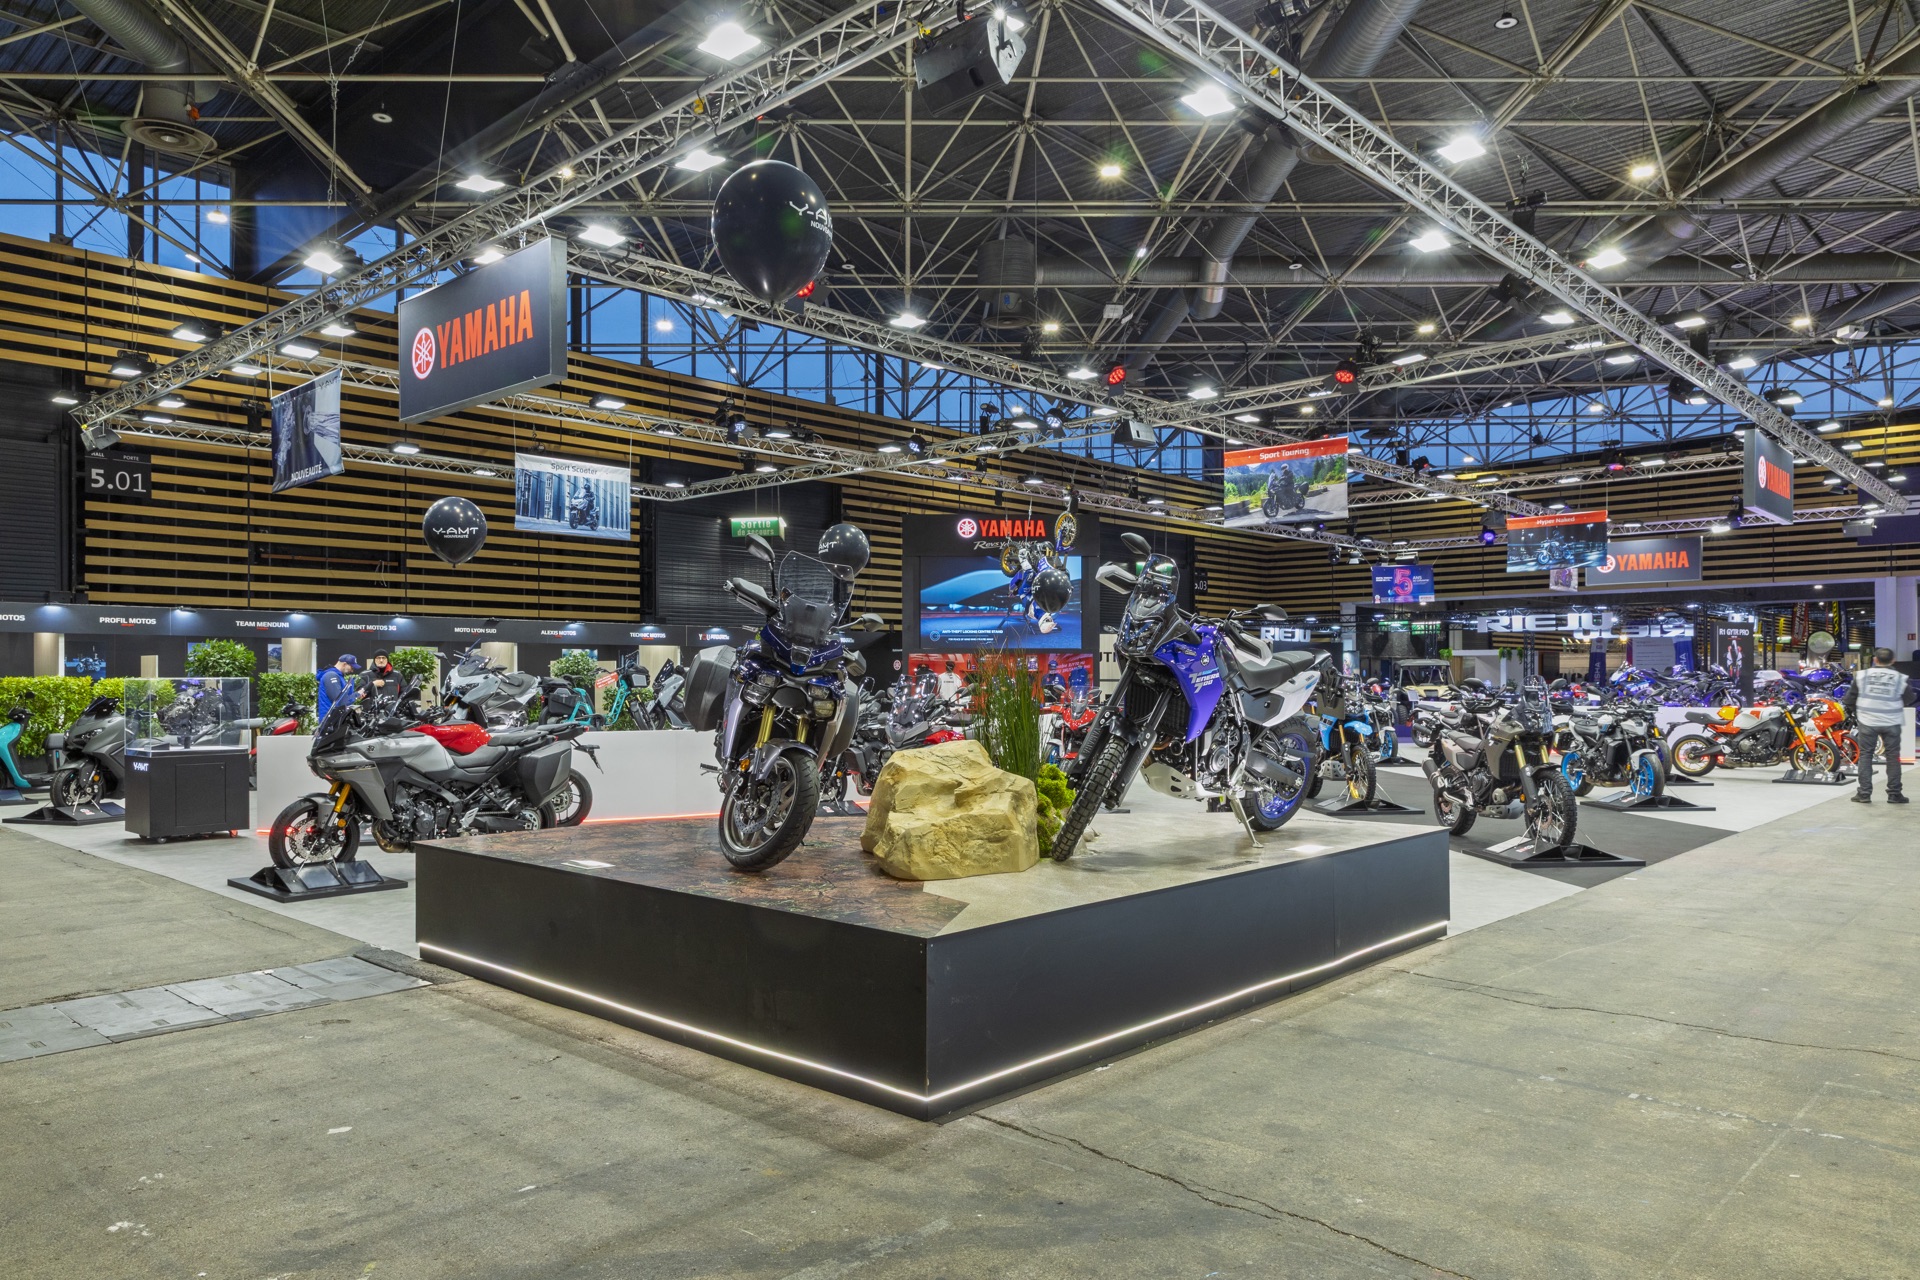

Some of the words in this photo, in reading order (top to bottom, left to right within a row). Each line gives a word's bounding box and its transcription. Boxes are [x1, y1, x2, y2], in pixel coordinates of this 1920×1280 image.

[436, 289, 534, 369] YAMAHA
[1260, 451, 1280, 461] Sport
[1281, 448, 1310, 457] Touring
[291, 463, 322, 481] NOUVEAUTÉ
[551, 462, 570, 472] Sport
[572, 466, 598, 475] Scooter
[91, 468, 147, 493] 5.01
[1766, 461, 1790, 500] YAMAHA
[432, 527, 479, 535] Y-AMT
[740, 520, 771, 529] Sortie
[979, 519, 1046, 537] YAMAHA
[1616, 551, 1689, 571] YAMAHA
[99, 616, 128, 624] PROFIL
[1477, 613, 1613, 633] RIEJU
[1260, 626, 1311, 642] RIEJU
